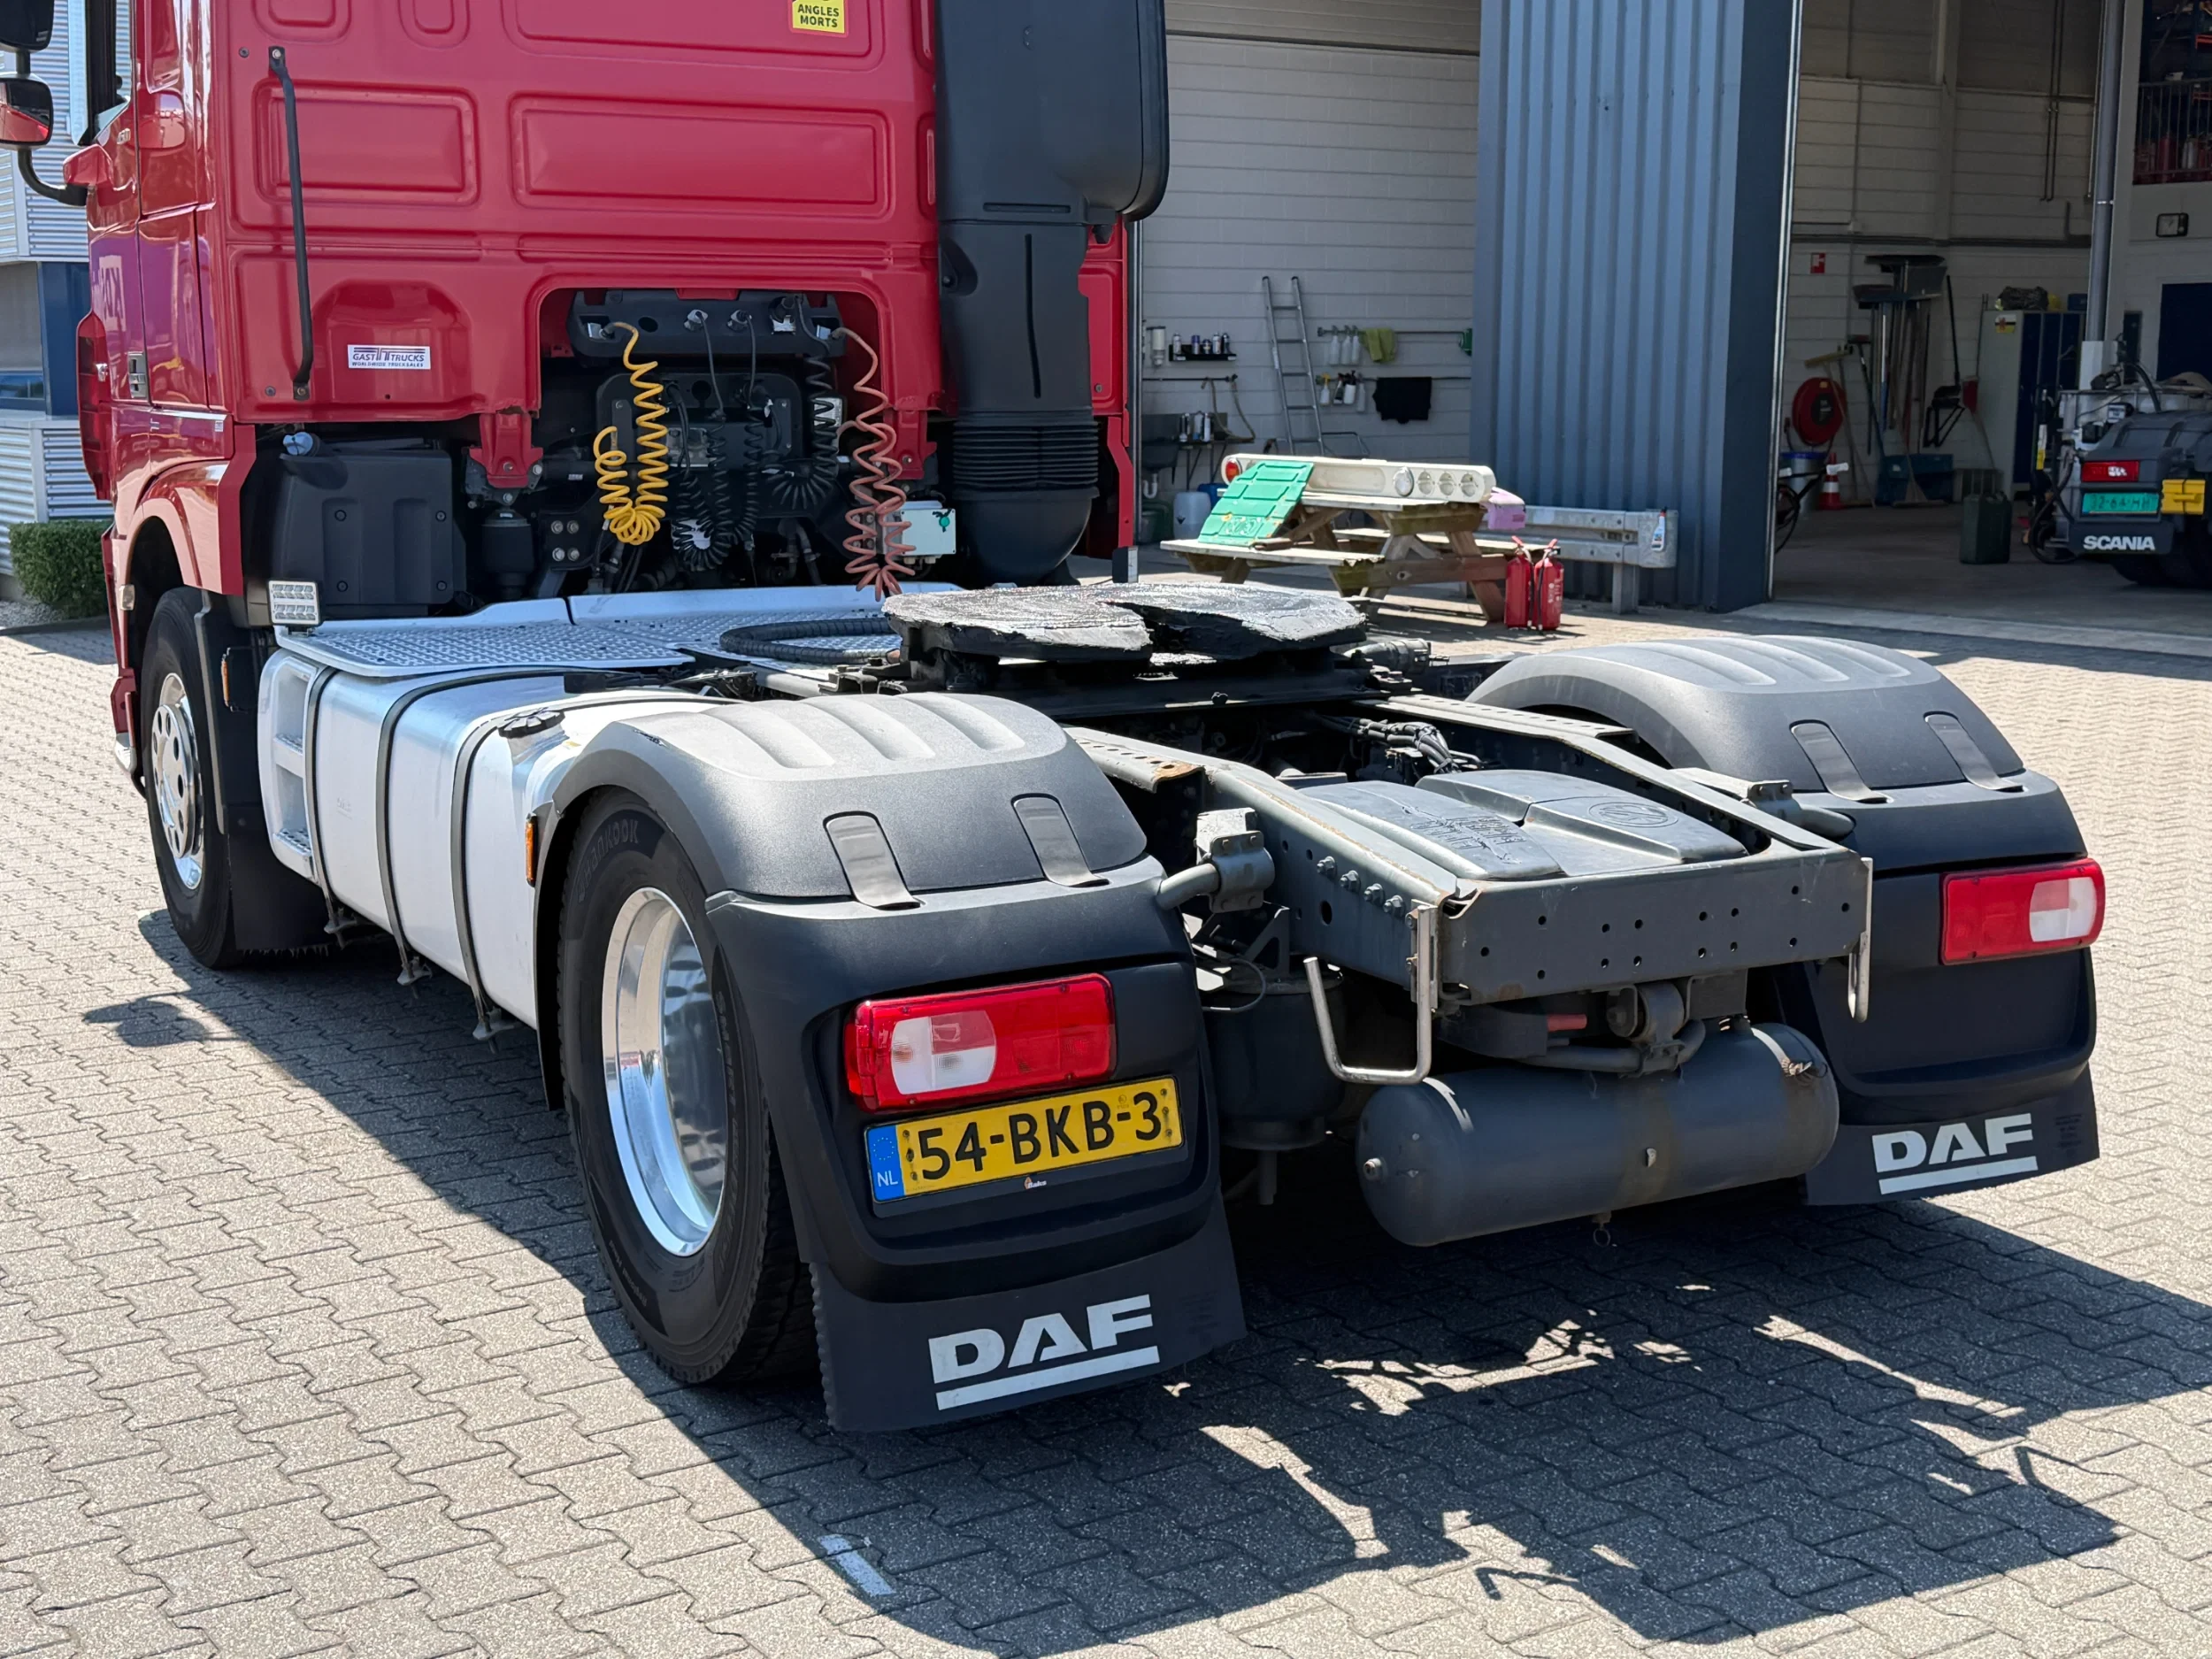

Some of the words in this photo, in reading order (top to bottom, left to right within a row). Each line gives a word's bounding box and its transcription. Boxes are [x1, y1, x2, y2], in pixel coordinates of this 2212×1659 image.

[797, 4, 840, 17] ANGLES
[800, 15, 838, 27] MORTS
[390, 353, 425, 362] TRUCKS
[2083, 534, 2155, 551] SCANIA
[918, 1091, 1163, 1181] 54-BKB-3
[1871, 1113, 2033, 1173] DAF
[877, 1169, 899, 1188] NL
[928, 1294, 1153, 1384] DAF
